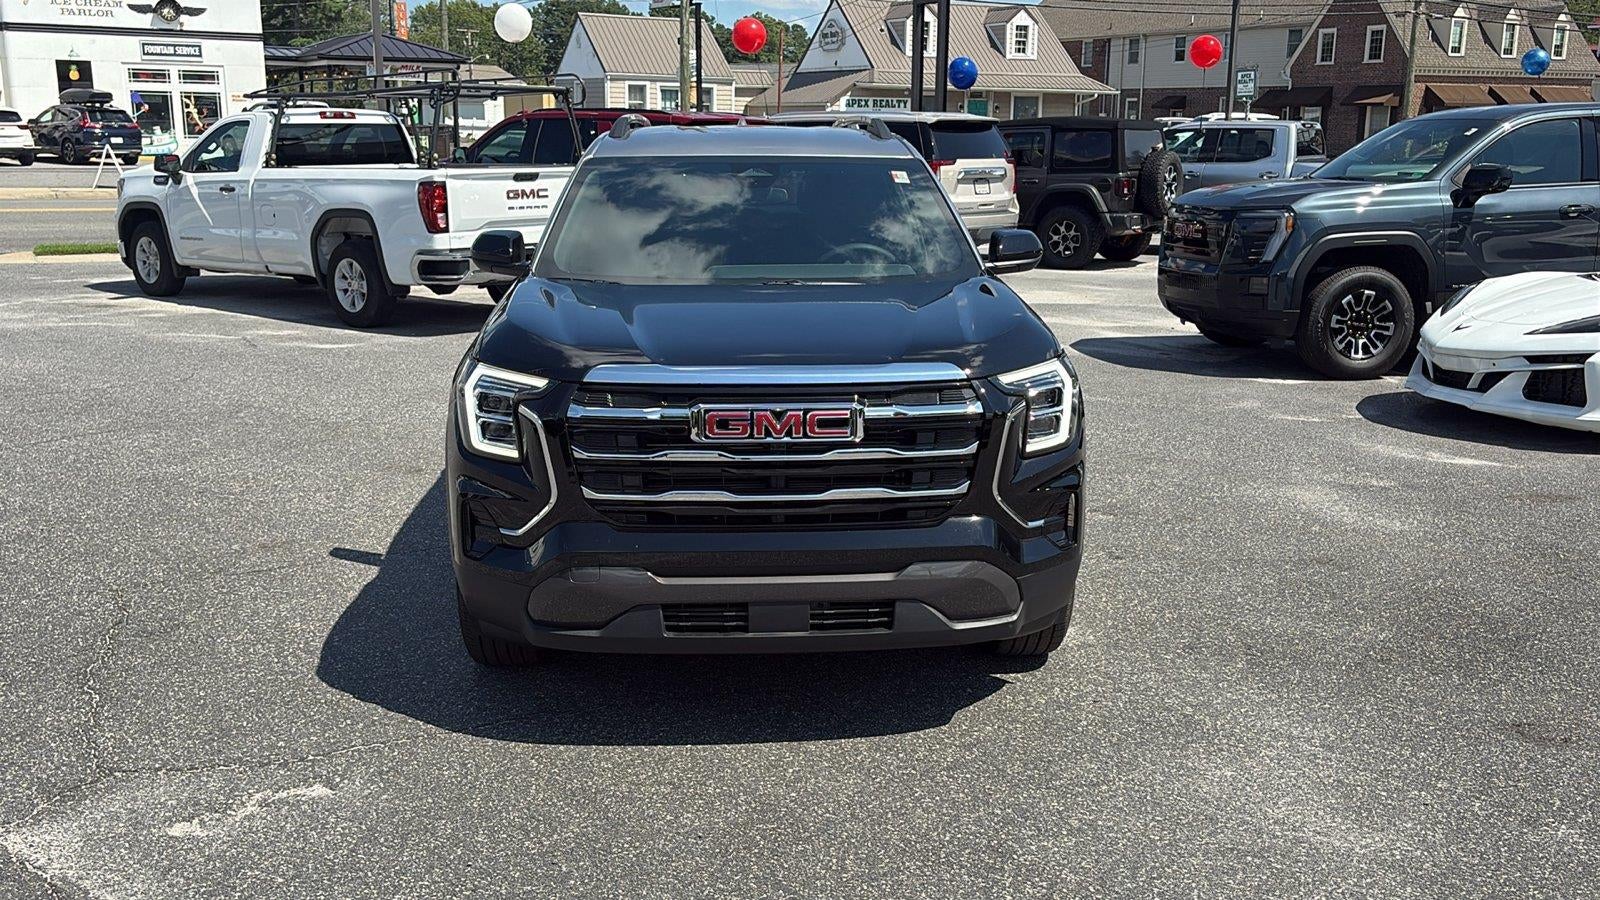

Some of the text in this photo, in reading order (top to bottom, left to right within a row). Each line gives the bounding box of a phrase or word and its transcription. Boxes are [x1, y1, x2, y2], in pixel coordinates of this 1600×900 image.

[75, 0, 123, 8] CREAM
[60, 8, 114, 18] PARLOR
[144, 45, 200, 55] FOUNTAIN SERVICE
[845, 99, 908, 109] APEX REALTY
[506, 188, 549, 200] GMC
[1174, 222, 1202, 238] GMC
[705, 410, 851, 438] GMC
